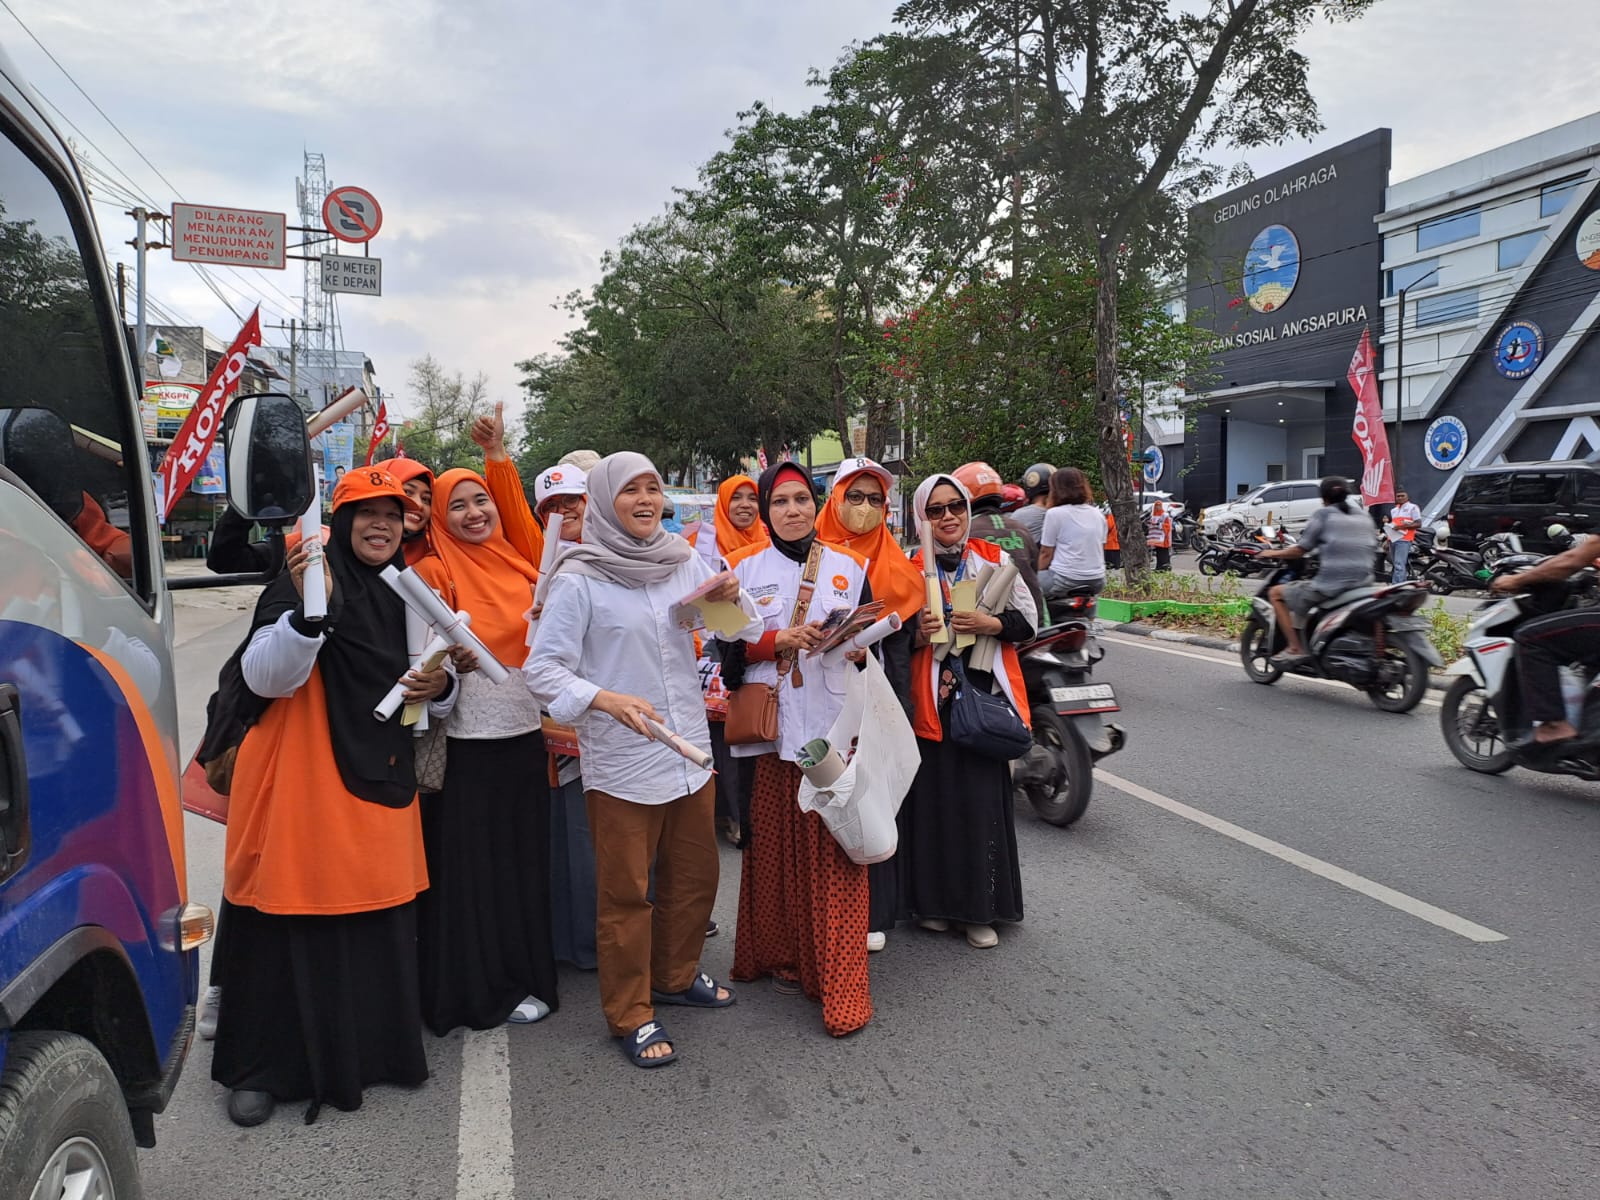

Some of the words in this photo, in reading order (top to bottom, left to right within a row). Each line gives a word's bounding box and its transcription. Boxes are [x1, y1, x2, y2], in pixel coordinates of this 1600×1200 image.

[1213, 194, 1261, 224] GEDUNG
[1264, 164, 1337, 205] OLAHRAGA
[195, 210, 264, 226] DILARANG
[339, 200, 364, 231] S
[187, 222, 274, 238] MENAIKKAN/
[183, 233, 275, 250] MENURUNKAN
[189, 246, 269, 261] PENUMPANG
[325, 260, 340, 272] 50
[343, 261, 376, 275] METER
[325, 274, 339, 286] KE
[343, 276, 376, 289] DEPAN
[1235, 327, 1278, 349] SOSIAL
[1281, 305, 1367, 338] ANGSAPURA
[178, 342, 255, 473] HOND
[856, 458, 866, 468] 8
[370, 472, 383, 486] 8
[544, 475, 552, 489] 8
[833, 590, 849, 600] PKS
